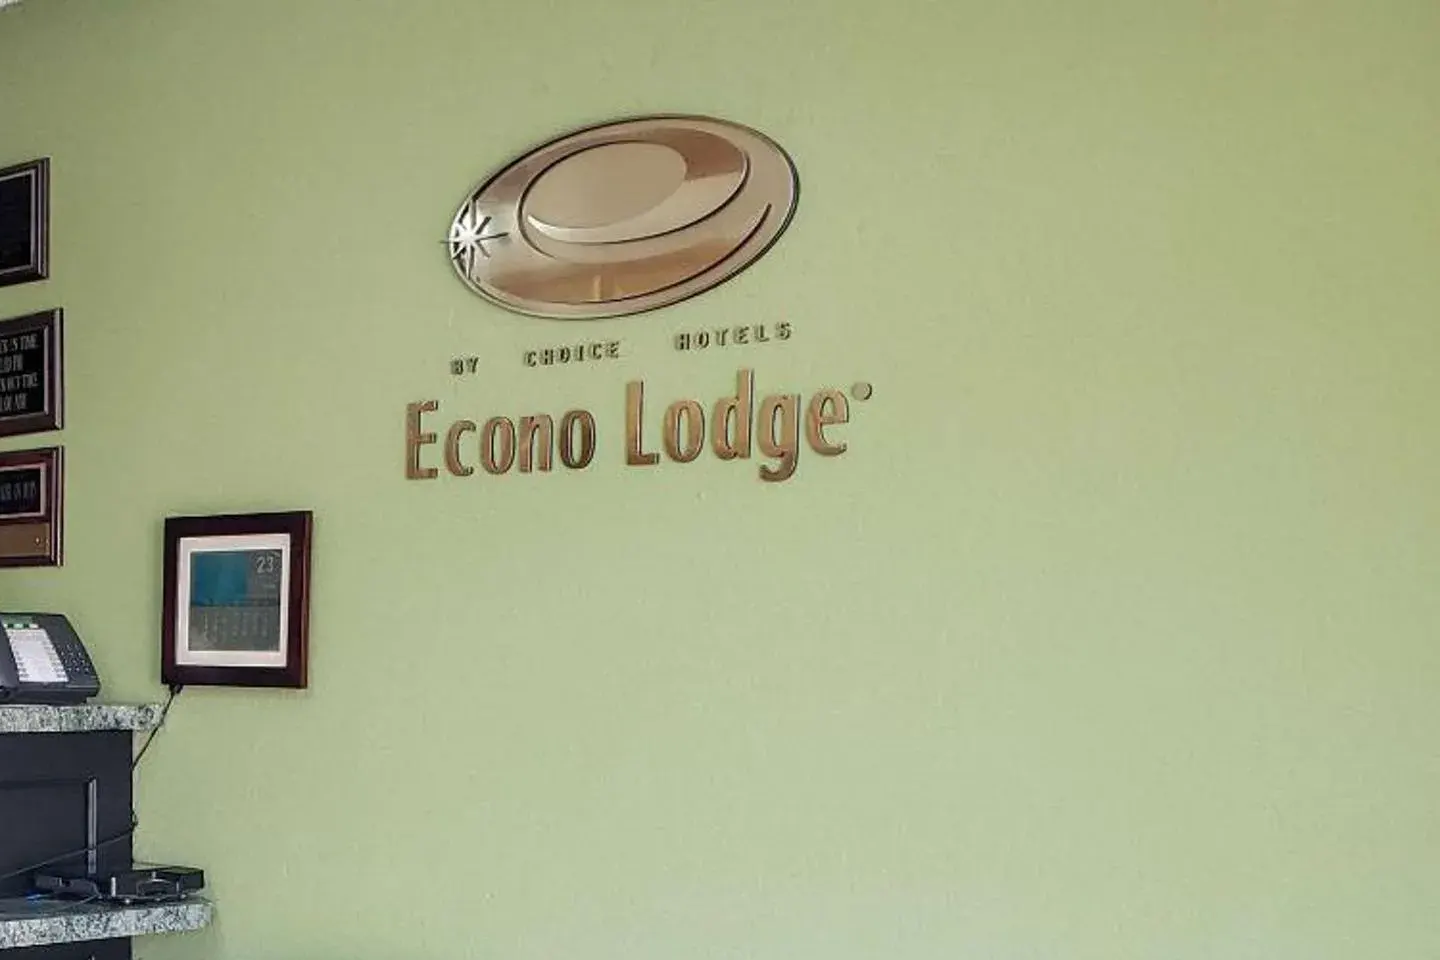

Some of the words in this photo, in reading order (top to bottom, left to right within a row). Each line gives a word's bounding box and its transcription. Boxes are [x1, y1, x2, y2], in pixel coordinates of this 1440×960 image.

[450, 355, 479, 375] BY
[524, 341, 620, 368] CHOICE
[675, 322, 792, 351] HOTELS
[405, 400, 597, 480] Econo
[626, 368, 850, 482] Lodge
